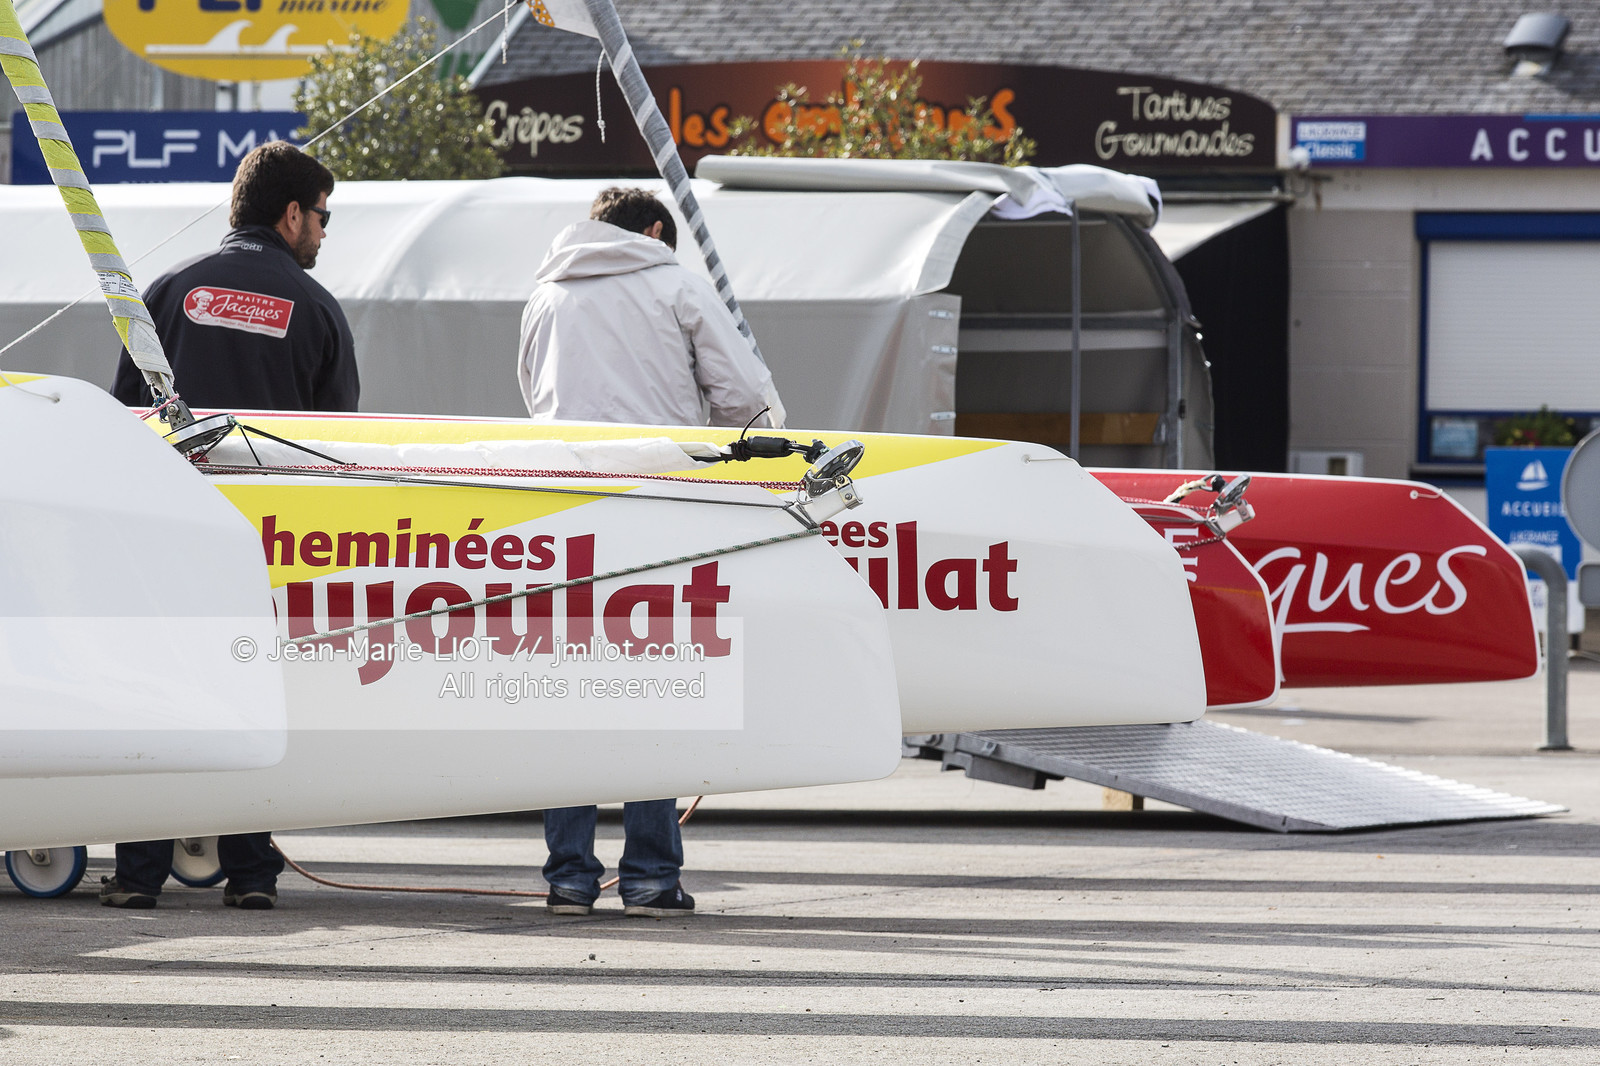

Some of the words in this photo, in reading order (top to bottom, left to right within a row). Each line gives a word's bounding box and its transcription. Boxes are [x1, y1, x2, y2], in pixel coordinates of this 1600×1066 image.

[669, 87, 730, 147] les
[1117, 86, 1232, 121] Tartines
[484, 99, 584, 158] Crêpes
[1095, 120, 1255, 160] Gourmandes
[1470, 128, 1600, 161] ACCU
[93, 129, 200, 168] PLF
[211, 294, 283, 324] Jacques
[271, 533, 731, 685] ujoulat
